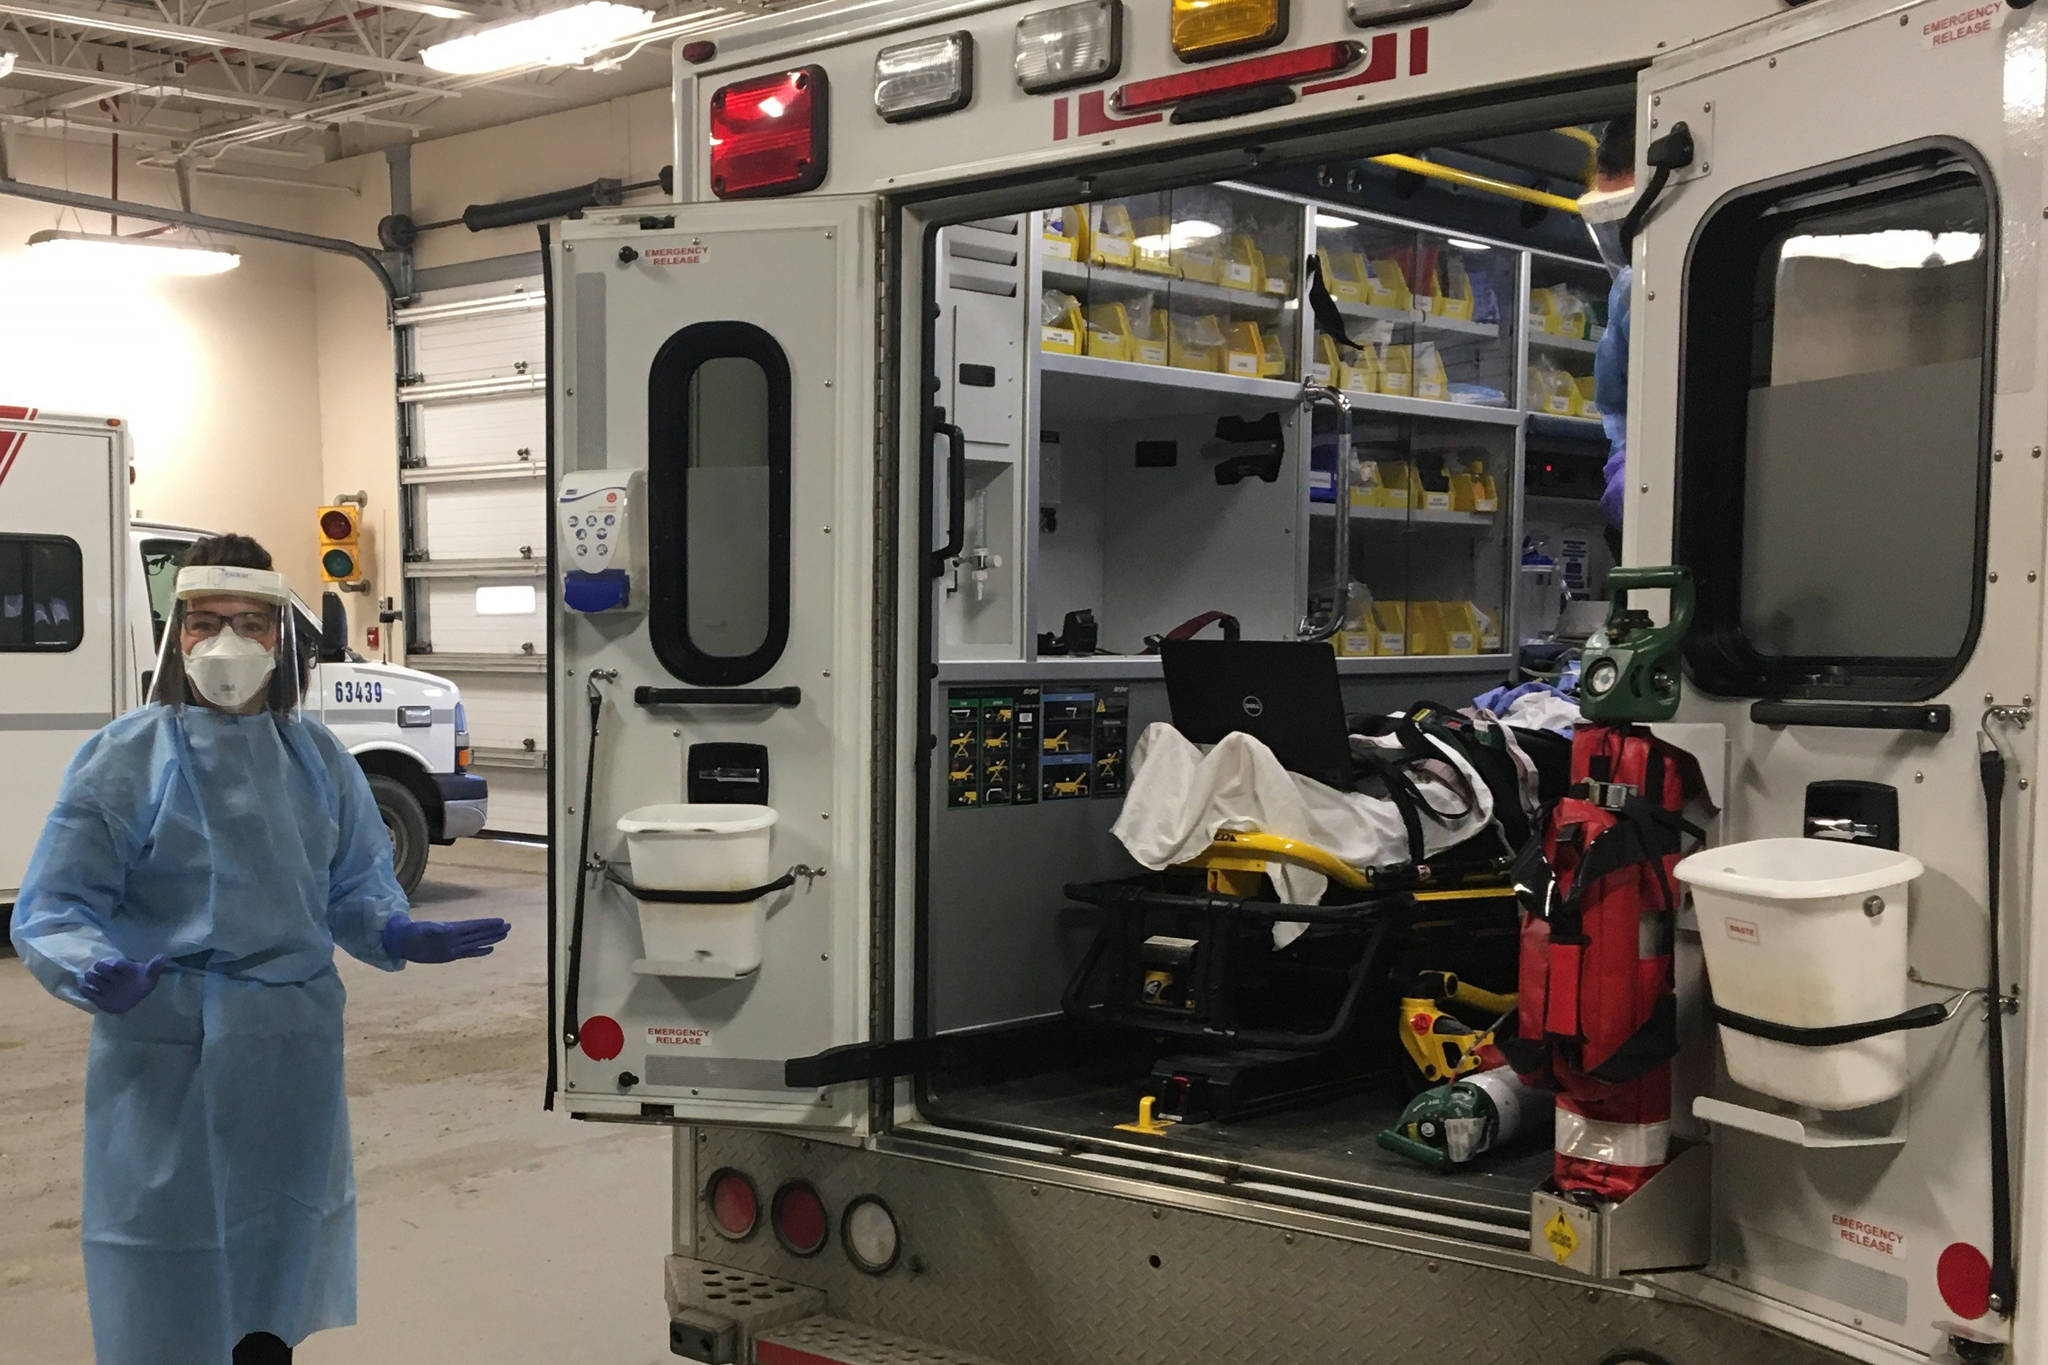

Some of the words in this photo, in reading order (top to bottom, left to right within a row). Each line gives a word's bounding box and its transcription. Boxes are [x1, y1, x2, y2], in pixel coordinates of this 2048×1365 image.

[1922, 2, 2001, 36] EMERGENCY
[1932, 20, 1991, 46] RELEASE
[645, 247, 708, 257] EMERGENCY
[653, 256, 700, 265] RELEASE
[335, 681, 382, 703] 63439
[647, 1027, 710, 1037] EMERGENCY
[655, 1036, 702, 1045] RELEASE
[1831, 1214, 1904, 1244] EMERGENCY
[1840, 1229, 1894, 1255] RELEASE
